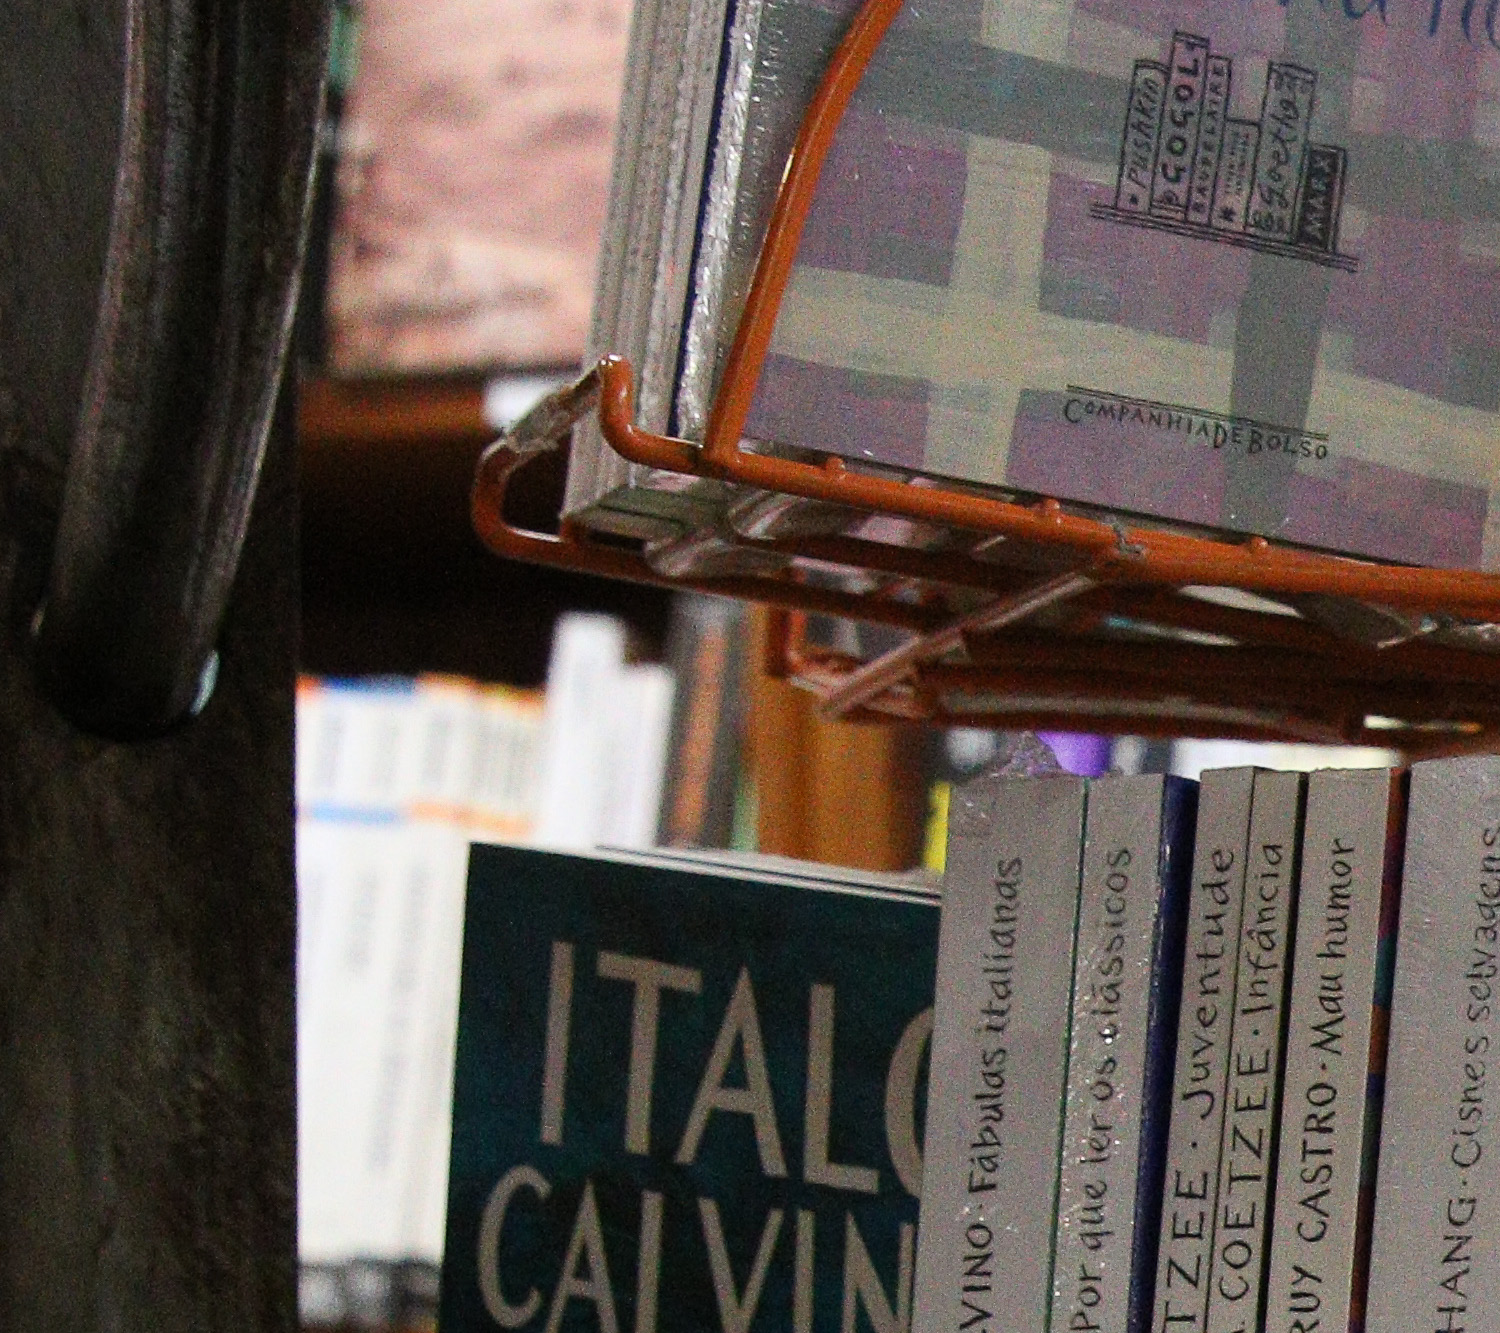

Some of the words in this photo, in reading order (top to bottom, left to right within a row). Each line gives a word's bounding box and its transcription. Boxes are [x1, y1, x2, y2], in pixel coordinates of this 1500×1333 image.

[1306, 153, 1334, 244] MARX
[979, 856, 1023, 1035] italianas
[1099, 846, 1132, 1039] clássicos
[1243, 843, 1284, 1017] Infância
[1318, 837, 1355, 959] humor
[1190, 847, 1234, 1119] Juventude
[1312, 975, 1345, 1057] Mau
[968, 1044, 1005, 1195] Fábulas
[1089, 1114, 1111, 1168] ler
[1096, 1055, 1119, 1103] os
[1452, 1034, 1489, 1171] Cisnes
[1075, 1195, 1108, 1254] que
[1218, 1050, 1270, 1302] COETZEE
[1298, 1083, 1339, 1245] CASTRO
[1070, 1266, 1100, 1331] Por
